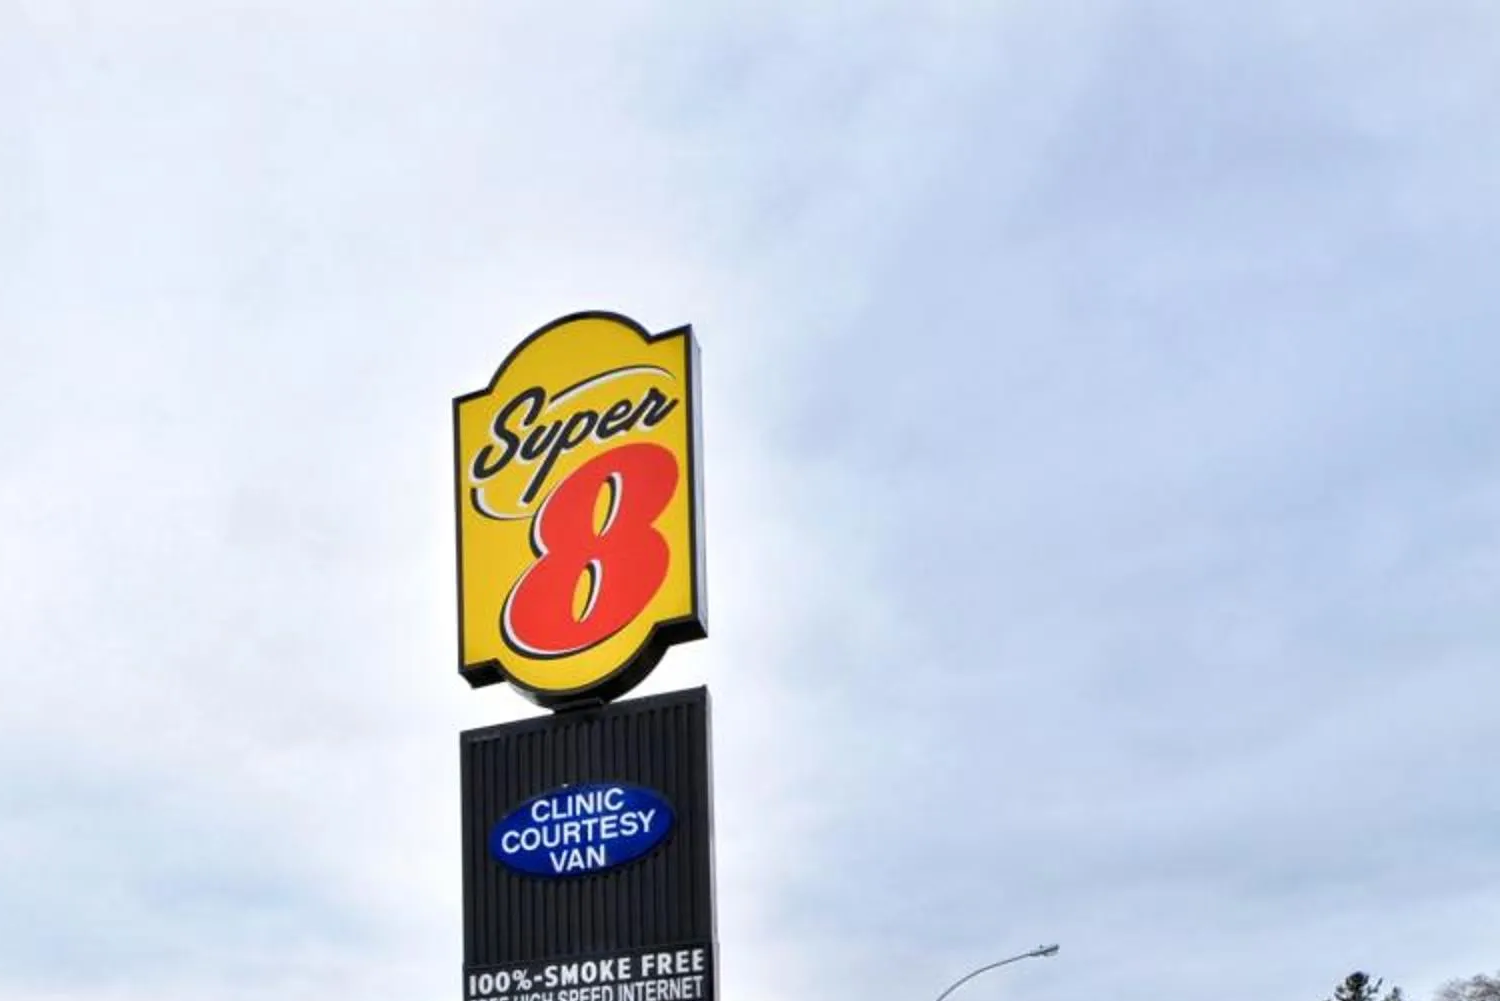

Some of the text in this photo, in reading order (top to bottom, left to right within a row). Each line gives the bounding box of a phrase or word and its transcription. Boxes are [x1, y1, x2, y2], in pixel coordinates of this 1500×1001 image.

[470, 385, 679, 505] Super
[500, 442, 679, 660] 8
[531, 787, 625, 823] CLINIC
[501, 809, 656, 853] COURTESY
[550, 844, 606, 873] VAN
[641, 949, 704, 977] FREE
